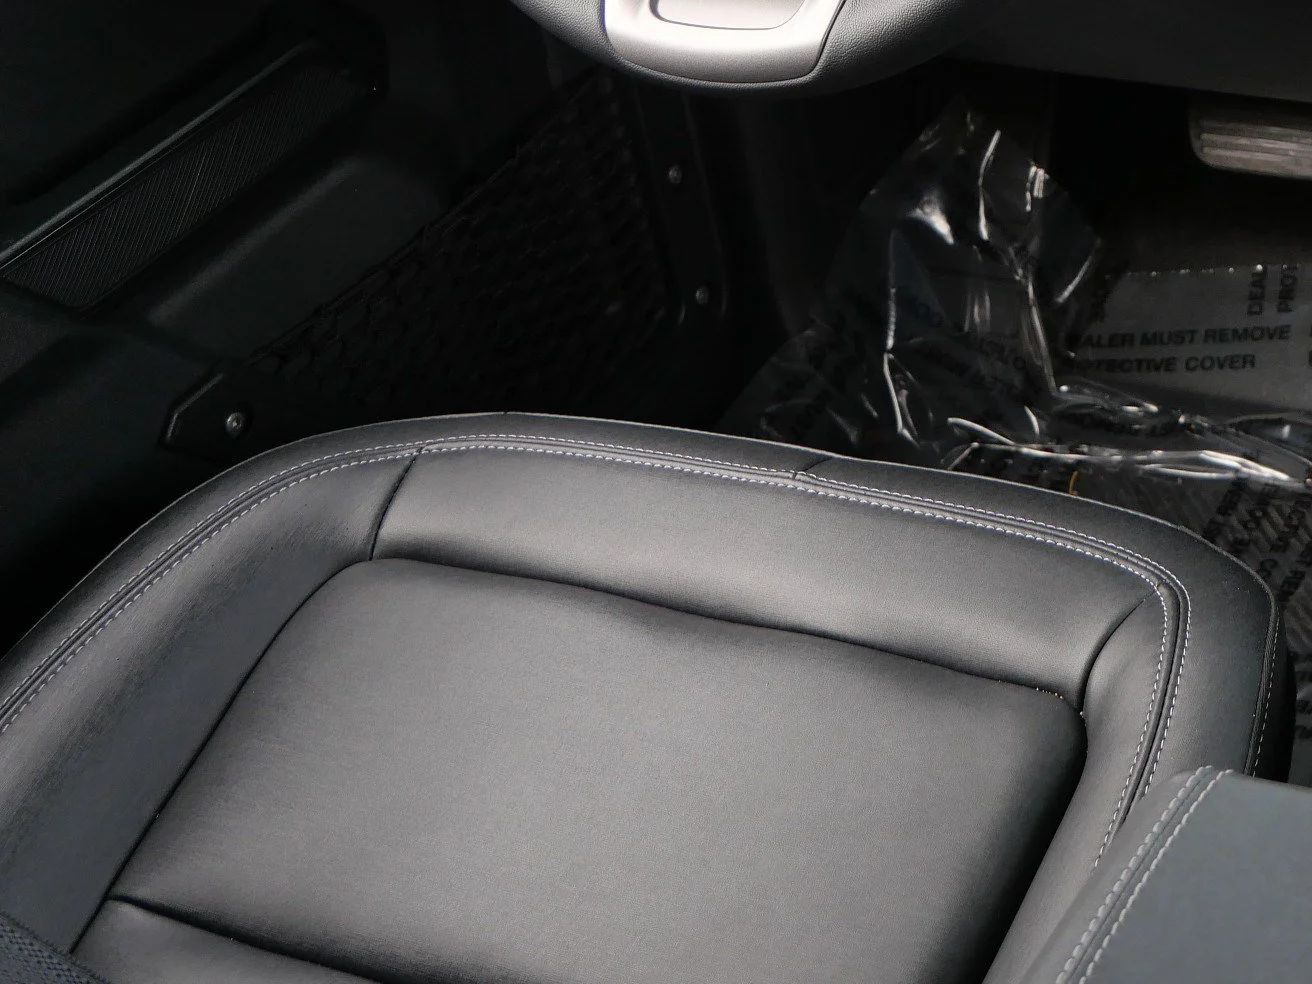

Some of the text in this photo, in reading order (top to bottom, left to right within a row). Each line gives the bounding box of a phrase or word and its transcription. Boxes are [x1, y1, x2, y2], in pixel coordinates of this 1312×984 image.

[1140, 328, 1199, 347] MUST
[1202, 324, 1292, 344] REMOVE
[1184, 354, 1257, 372] COVER
